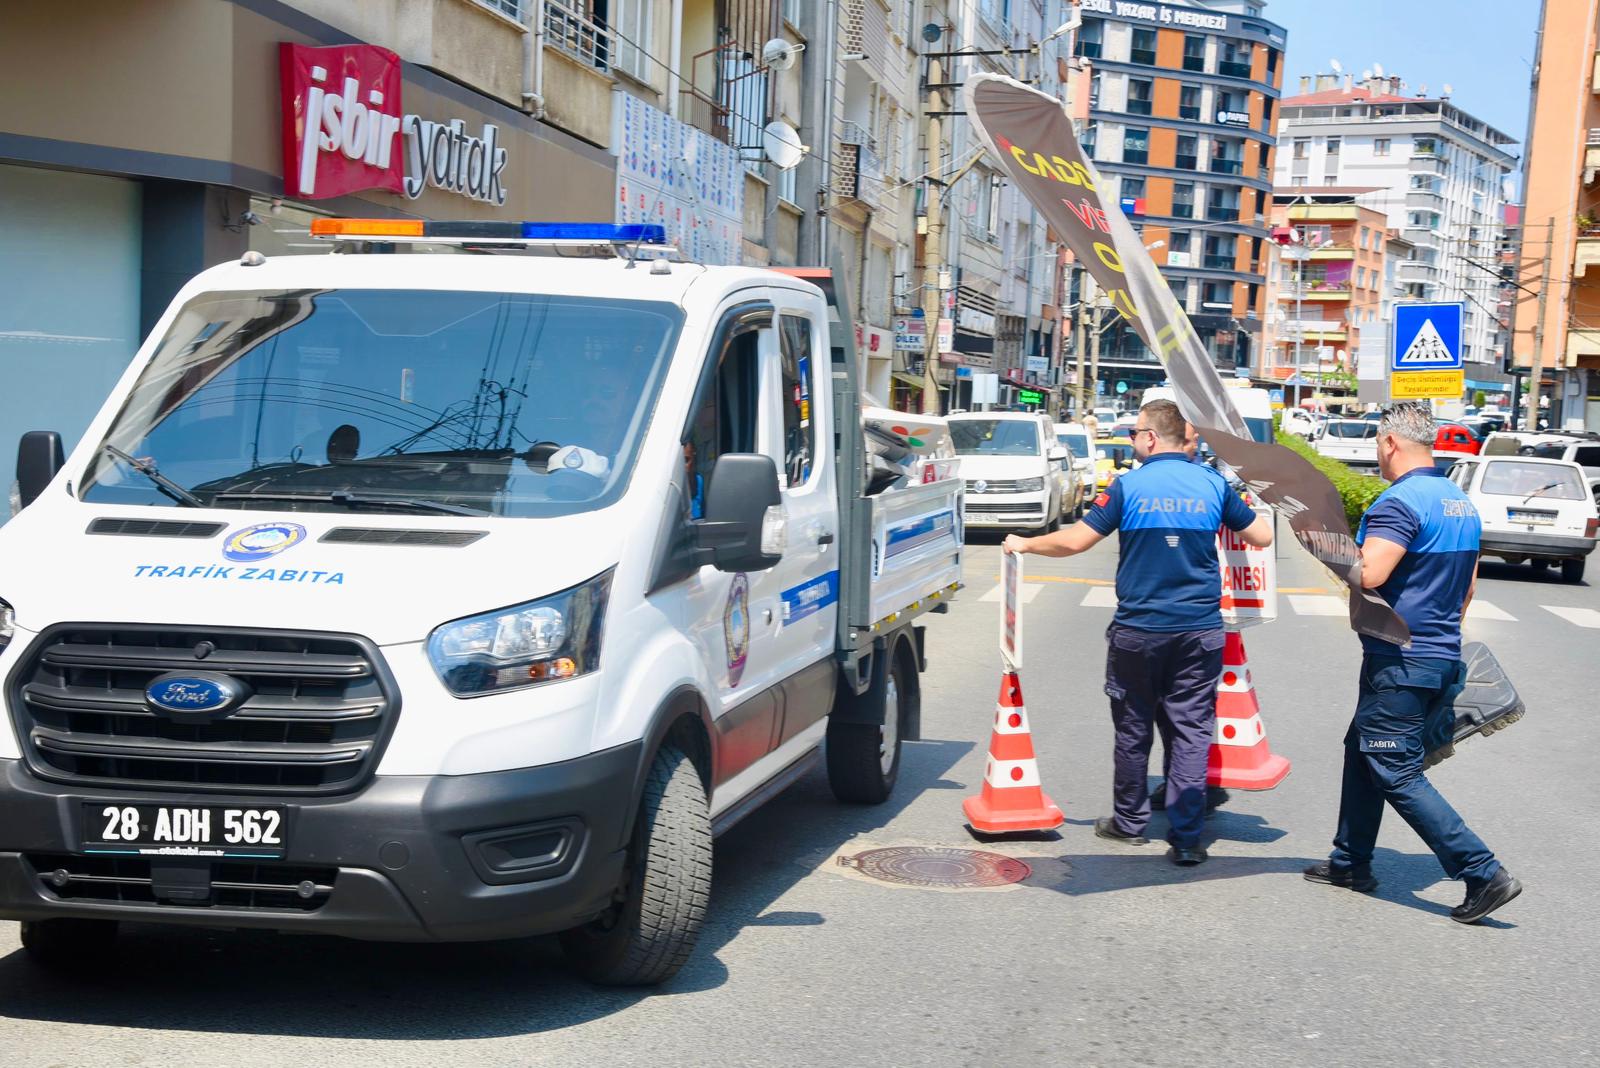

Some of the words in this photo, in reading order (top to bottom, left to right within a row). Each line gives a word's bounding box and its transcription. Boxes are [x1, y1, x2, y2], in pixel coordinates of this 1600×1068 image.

[1116, 3, 1157, 21] YAZAR
[1160, 5, 1173, 25] İŞ
[1174, 10, 1228, 30] MERKEZİ
[402, 115, 508, 207] yatak
[1138, 497, 1207, 513] ZABITA
[134, 563, 235, 579] TRAFİK
[238, 567, 345, 585] ZABITA
[1218, 561, 1267, 592] ANESİ
[162, 682, 212, 704] Ford
[1368, 740, 1397, 749] ZABITA
[102, 806, 140, 841] 28
[153, 807, 211, 843] ADH
[224, 809, 281, 844] 562
